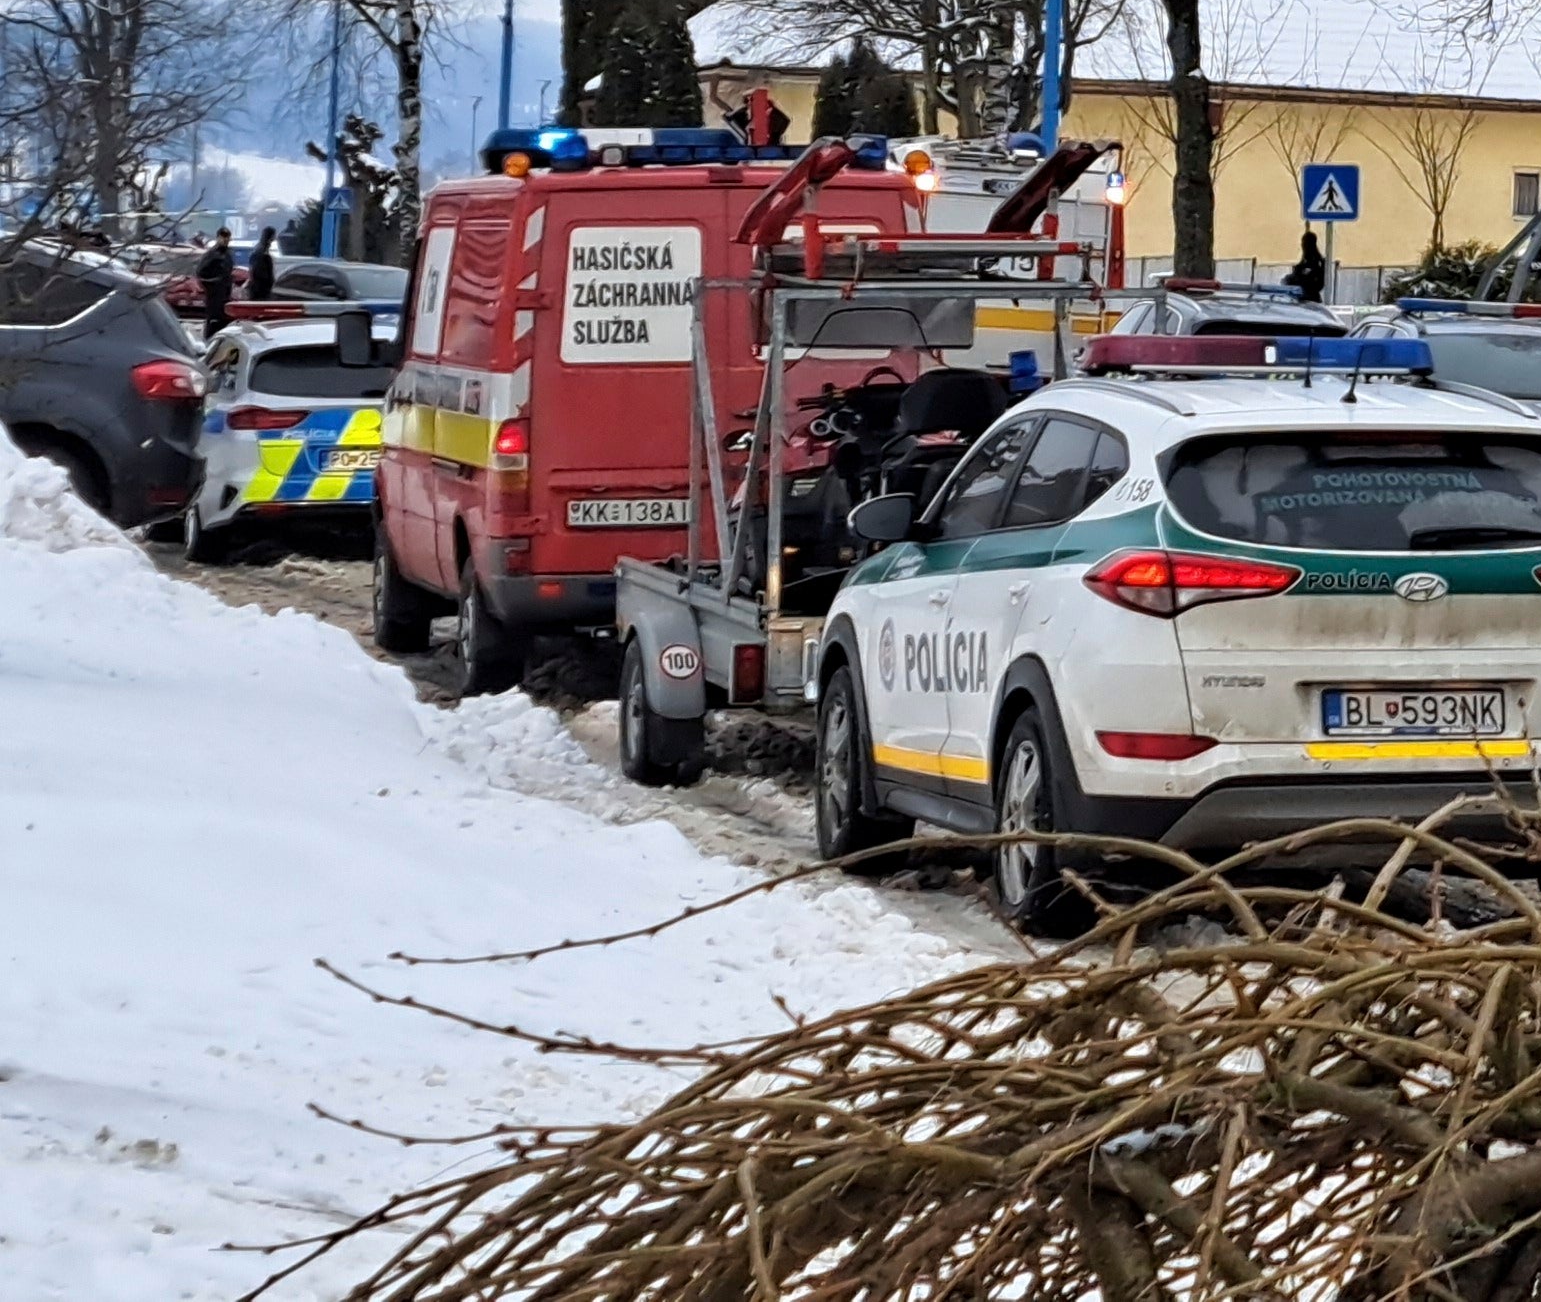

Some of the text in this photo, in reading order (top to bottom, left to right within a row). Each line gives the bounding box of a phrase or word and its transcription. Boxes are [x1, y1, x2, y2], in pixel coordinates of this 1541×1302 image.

[573, 241, 673, 271] HASIČSKÁ
[573, 277, 694, 308] ZÁCHRANNÁ
[573, 315, 650, 345] SLUŽBA
[1126, 478, 1154, 503] 158
[1307, 568, 1391, 589] POLÍCIA
[664, 652, 695, 670] 100
[904, 617, 988, 693] POLÍCIA
